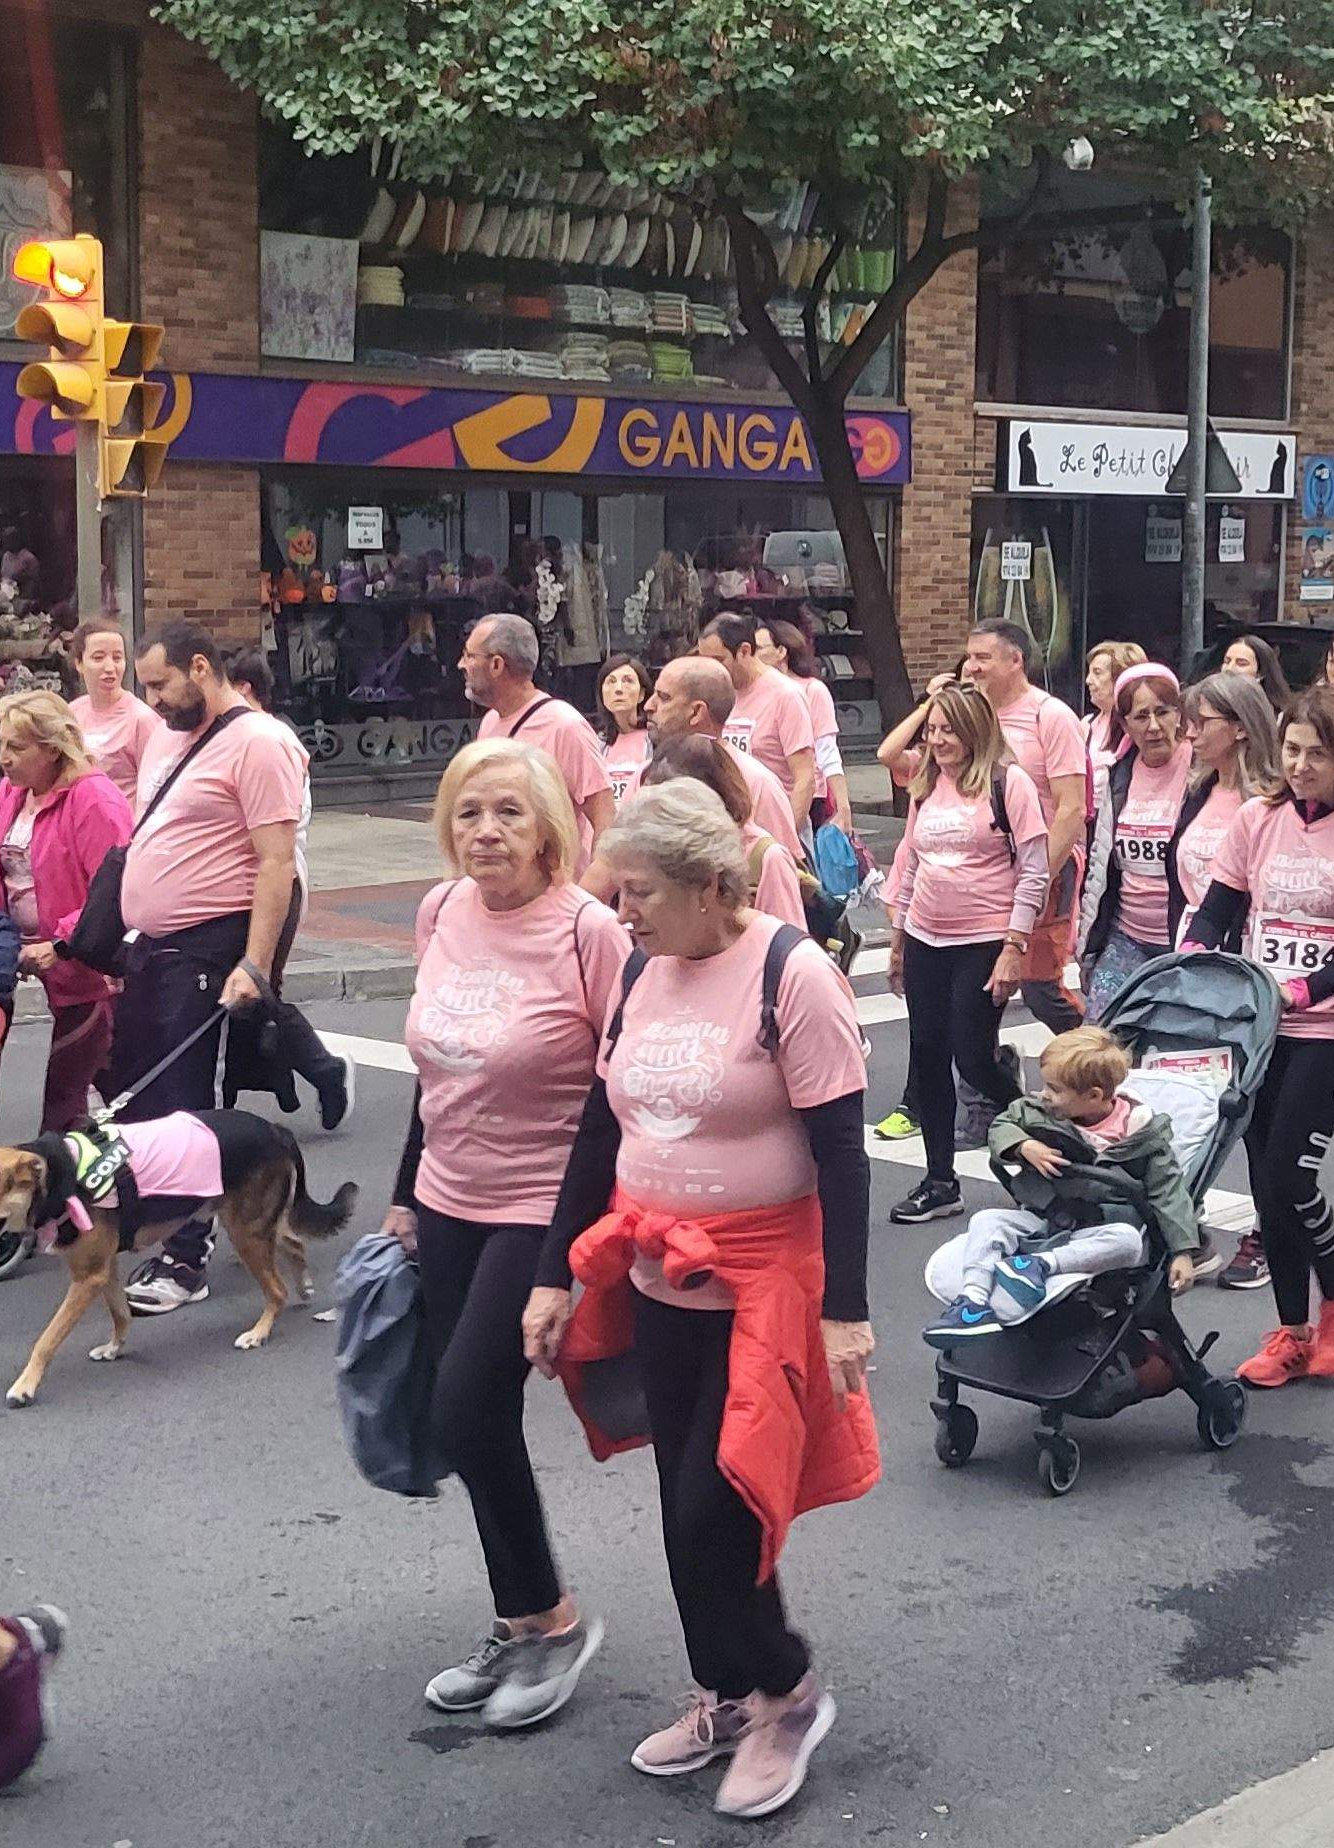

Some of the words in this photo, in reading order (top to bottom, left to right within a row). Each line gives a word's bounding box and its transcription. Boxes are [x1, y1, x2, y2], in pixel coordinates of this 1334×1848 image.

[618, 407, 814, 473] GANGA
[1059, 443, 1086, 474] Le
[1092, 441, 1146, 478] Petit
[1115, 838, 1169, 861] 1988
